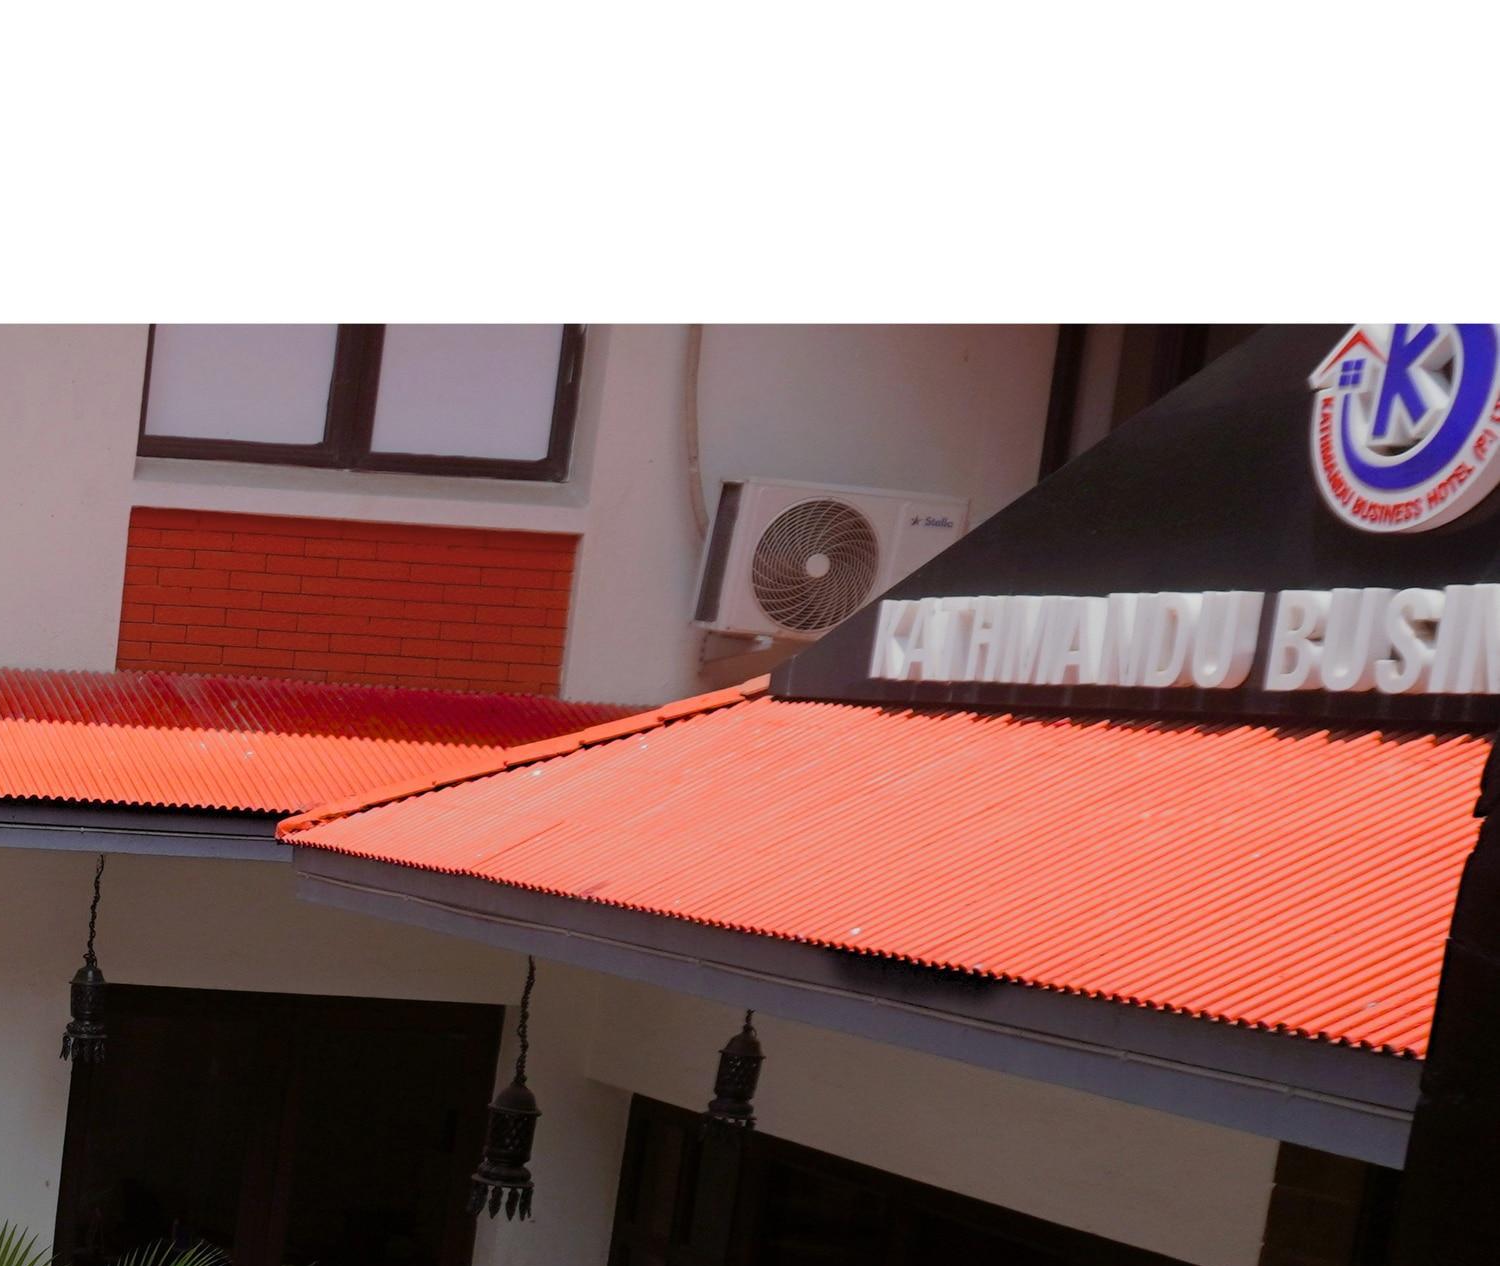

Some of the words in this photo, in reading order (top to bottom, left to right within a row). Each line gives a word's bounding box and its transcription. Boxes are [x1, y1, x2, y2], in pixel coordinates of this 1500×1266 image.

[1351, 497, 1424, 524] BUSINESS
[1426, 462, 1476, 508] HOTEL
[869, 590, 1265, 689] KATHMANDU
